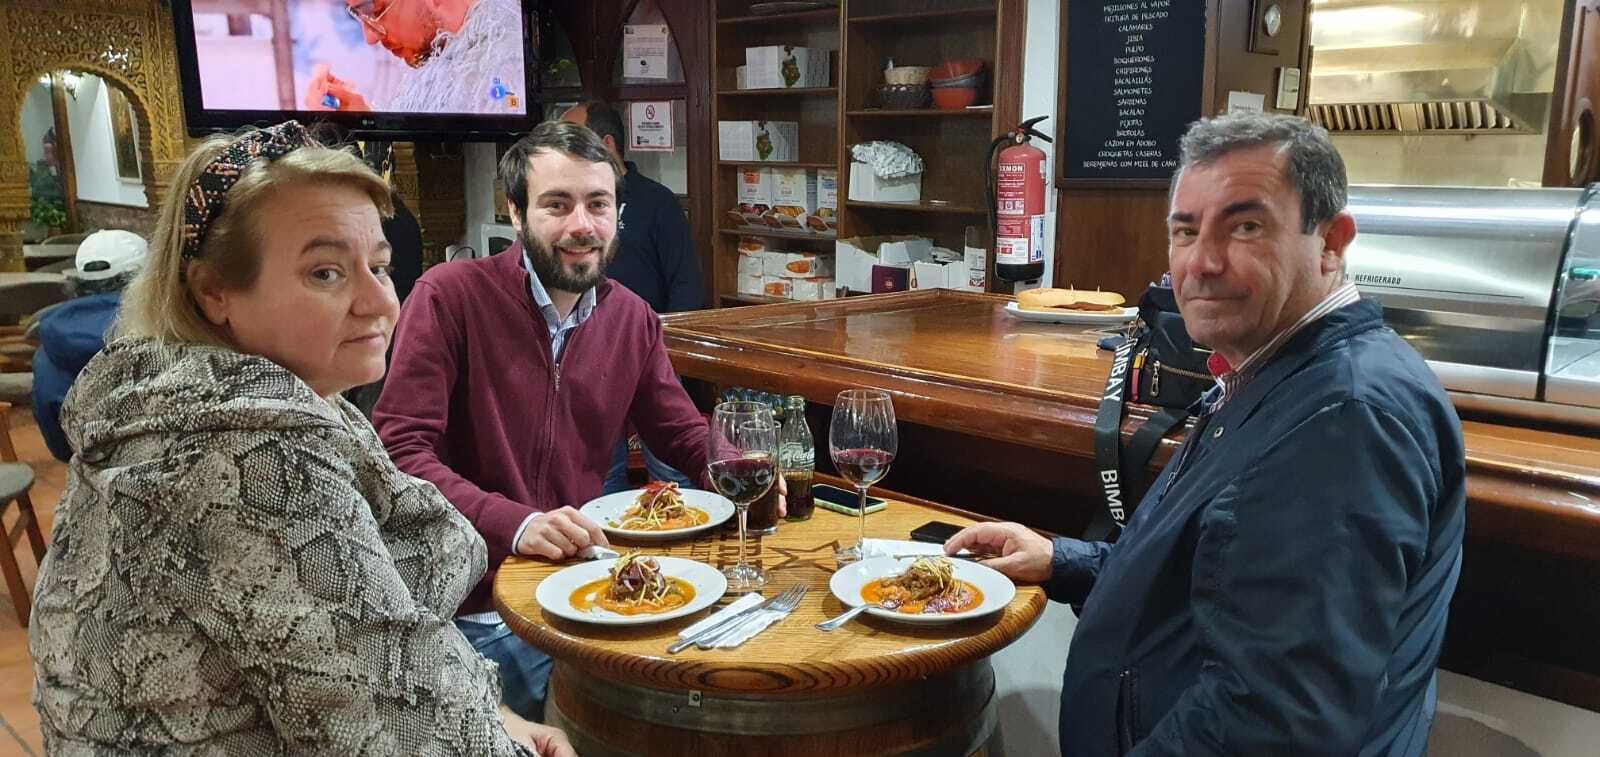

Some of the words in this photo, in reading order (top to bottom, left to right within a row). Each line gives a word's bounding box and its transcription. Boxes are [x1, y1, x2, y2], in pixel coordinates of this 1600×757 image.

[1141, 1, 1148, 9] AL
[1131, 13, 1139, 21] DE
[1141, 11, 1169, 21] PESCADO
[1118, 23, 1153, 33] CALAMARES
[1125, 45, 1145, 54] PULPO
[1113, 55, 1155, 65] BOQUERONES
[1115, 66, 1153, 75] CHIPIRONES
[1112, 87, 1153, 96] SALMONETES
[1119, 108, 1145, 117] BACALAO
[1136, 139, 1157, 147] ADOBO
[1097, 150, 1134, 158] CROQUETAS
[1135, 150, 1162, 158] CASERAS
[1083, 160, 1118, 169] BERENJENAS
[1120, 160, 1133, 168] CON
[1134, 160, 1149, 168] MIEL
[1151, 160, 1159, 168] DE
[1355, 274, 1402, 285] REFRIGERADO
